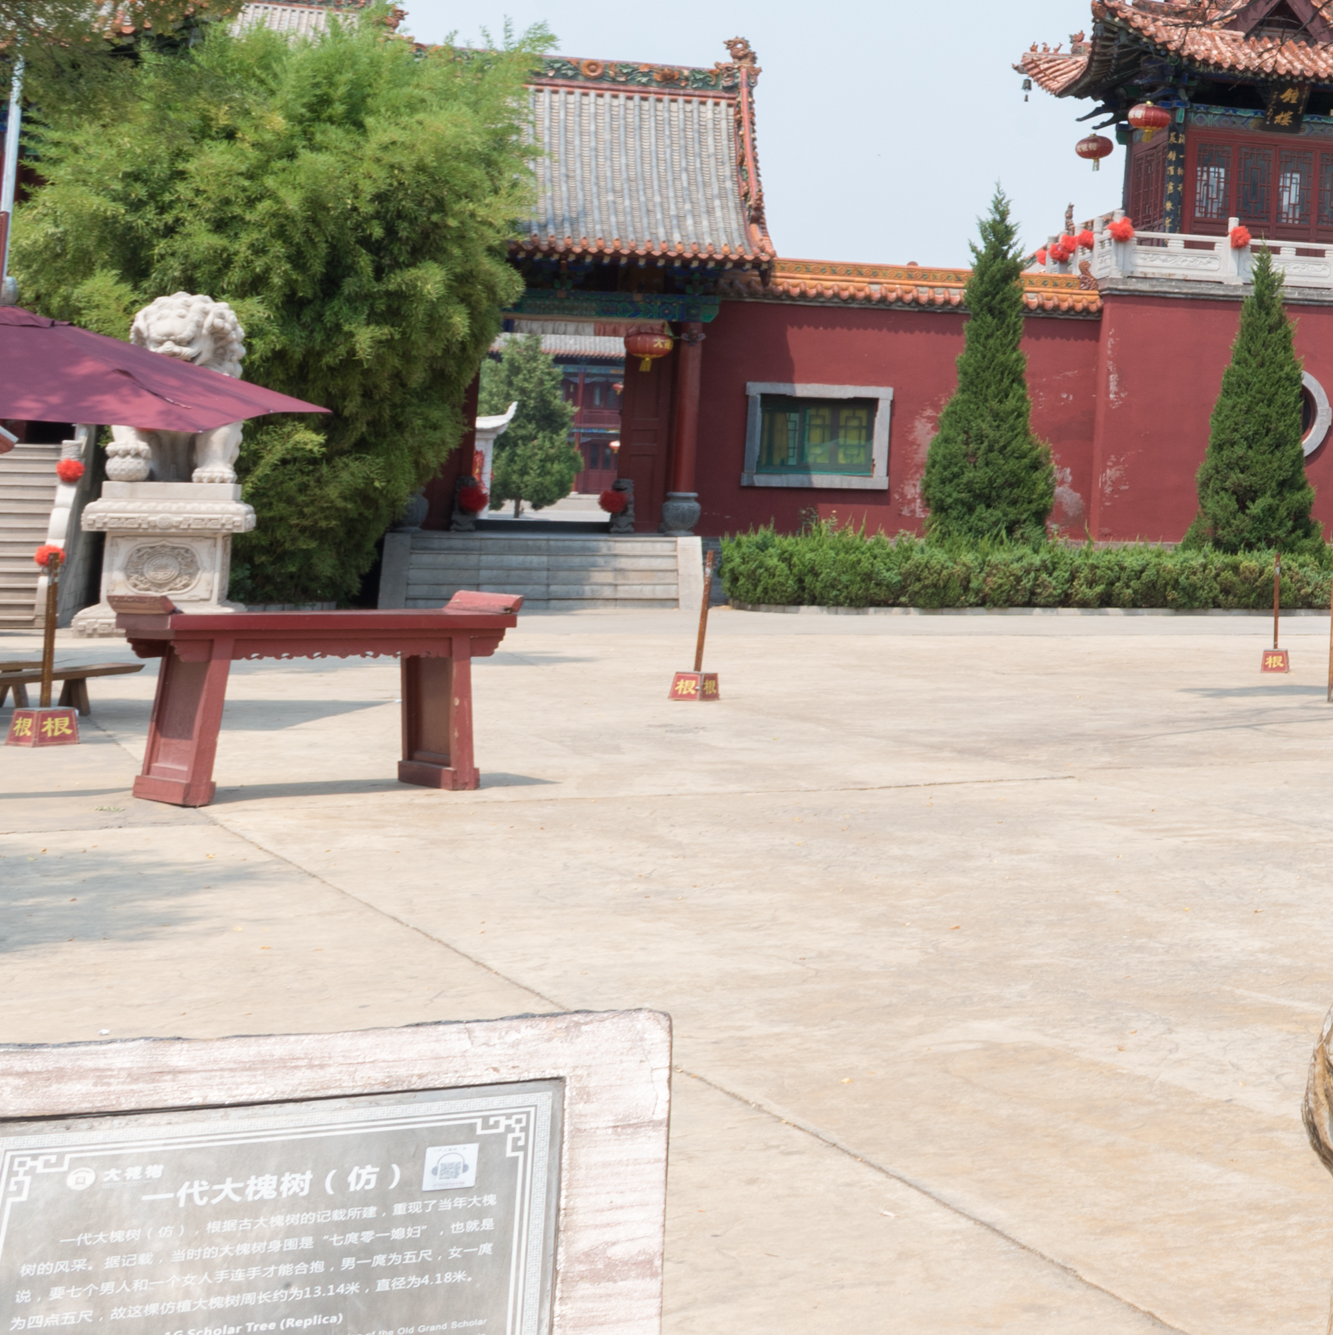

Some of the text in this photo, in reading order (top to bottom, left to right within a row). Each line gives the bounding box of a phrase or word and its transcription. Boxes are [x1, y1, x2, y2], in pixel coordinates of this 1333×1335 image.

[1265, 655, 1285, 669] 根
[675, 679, 696, 695] 根
[703, 679, 717, 695] 根
[13, 716, 32, 737] 根
[41, 717, 73, 737] 根
[246, 1322, 276, 1333] Tree
[280, 1313, 343, 1331] (Replica)
[397, 1326, 415, 1335] Old
[418, 1322, 448, 1333] Grand
[450, 1318, 488, 1329] Scholar
